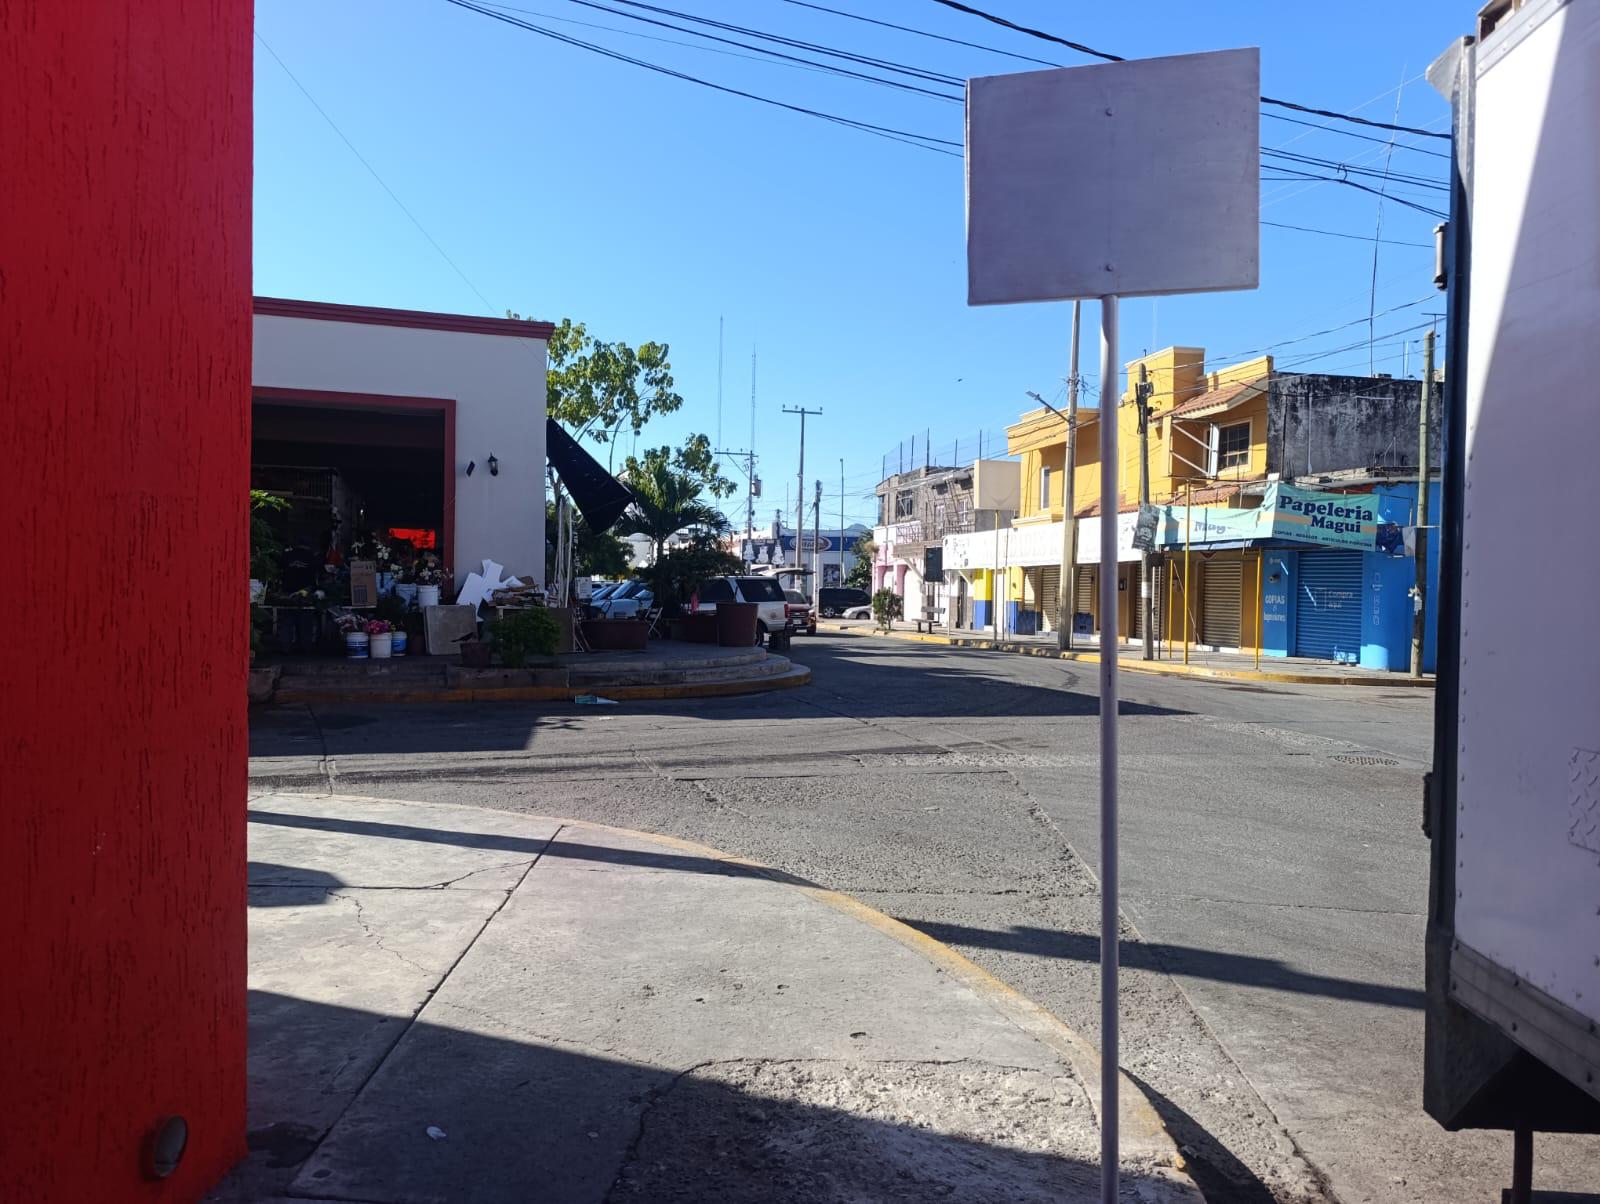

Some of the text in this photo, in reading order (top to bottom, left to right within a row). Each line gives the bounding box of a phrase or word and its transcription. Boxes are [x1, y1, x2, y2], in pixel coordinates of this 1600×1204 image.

[1279, 495, 1373, 521] Papeleria
[1310, 515, 1361, 533] Magui
[1265, 594, 1285, 604] COPIAS
